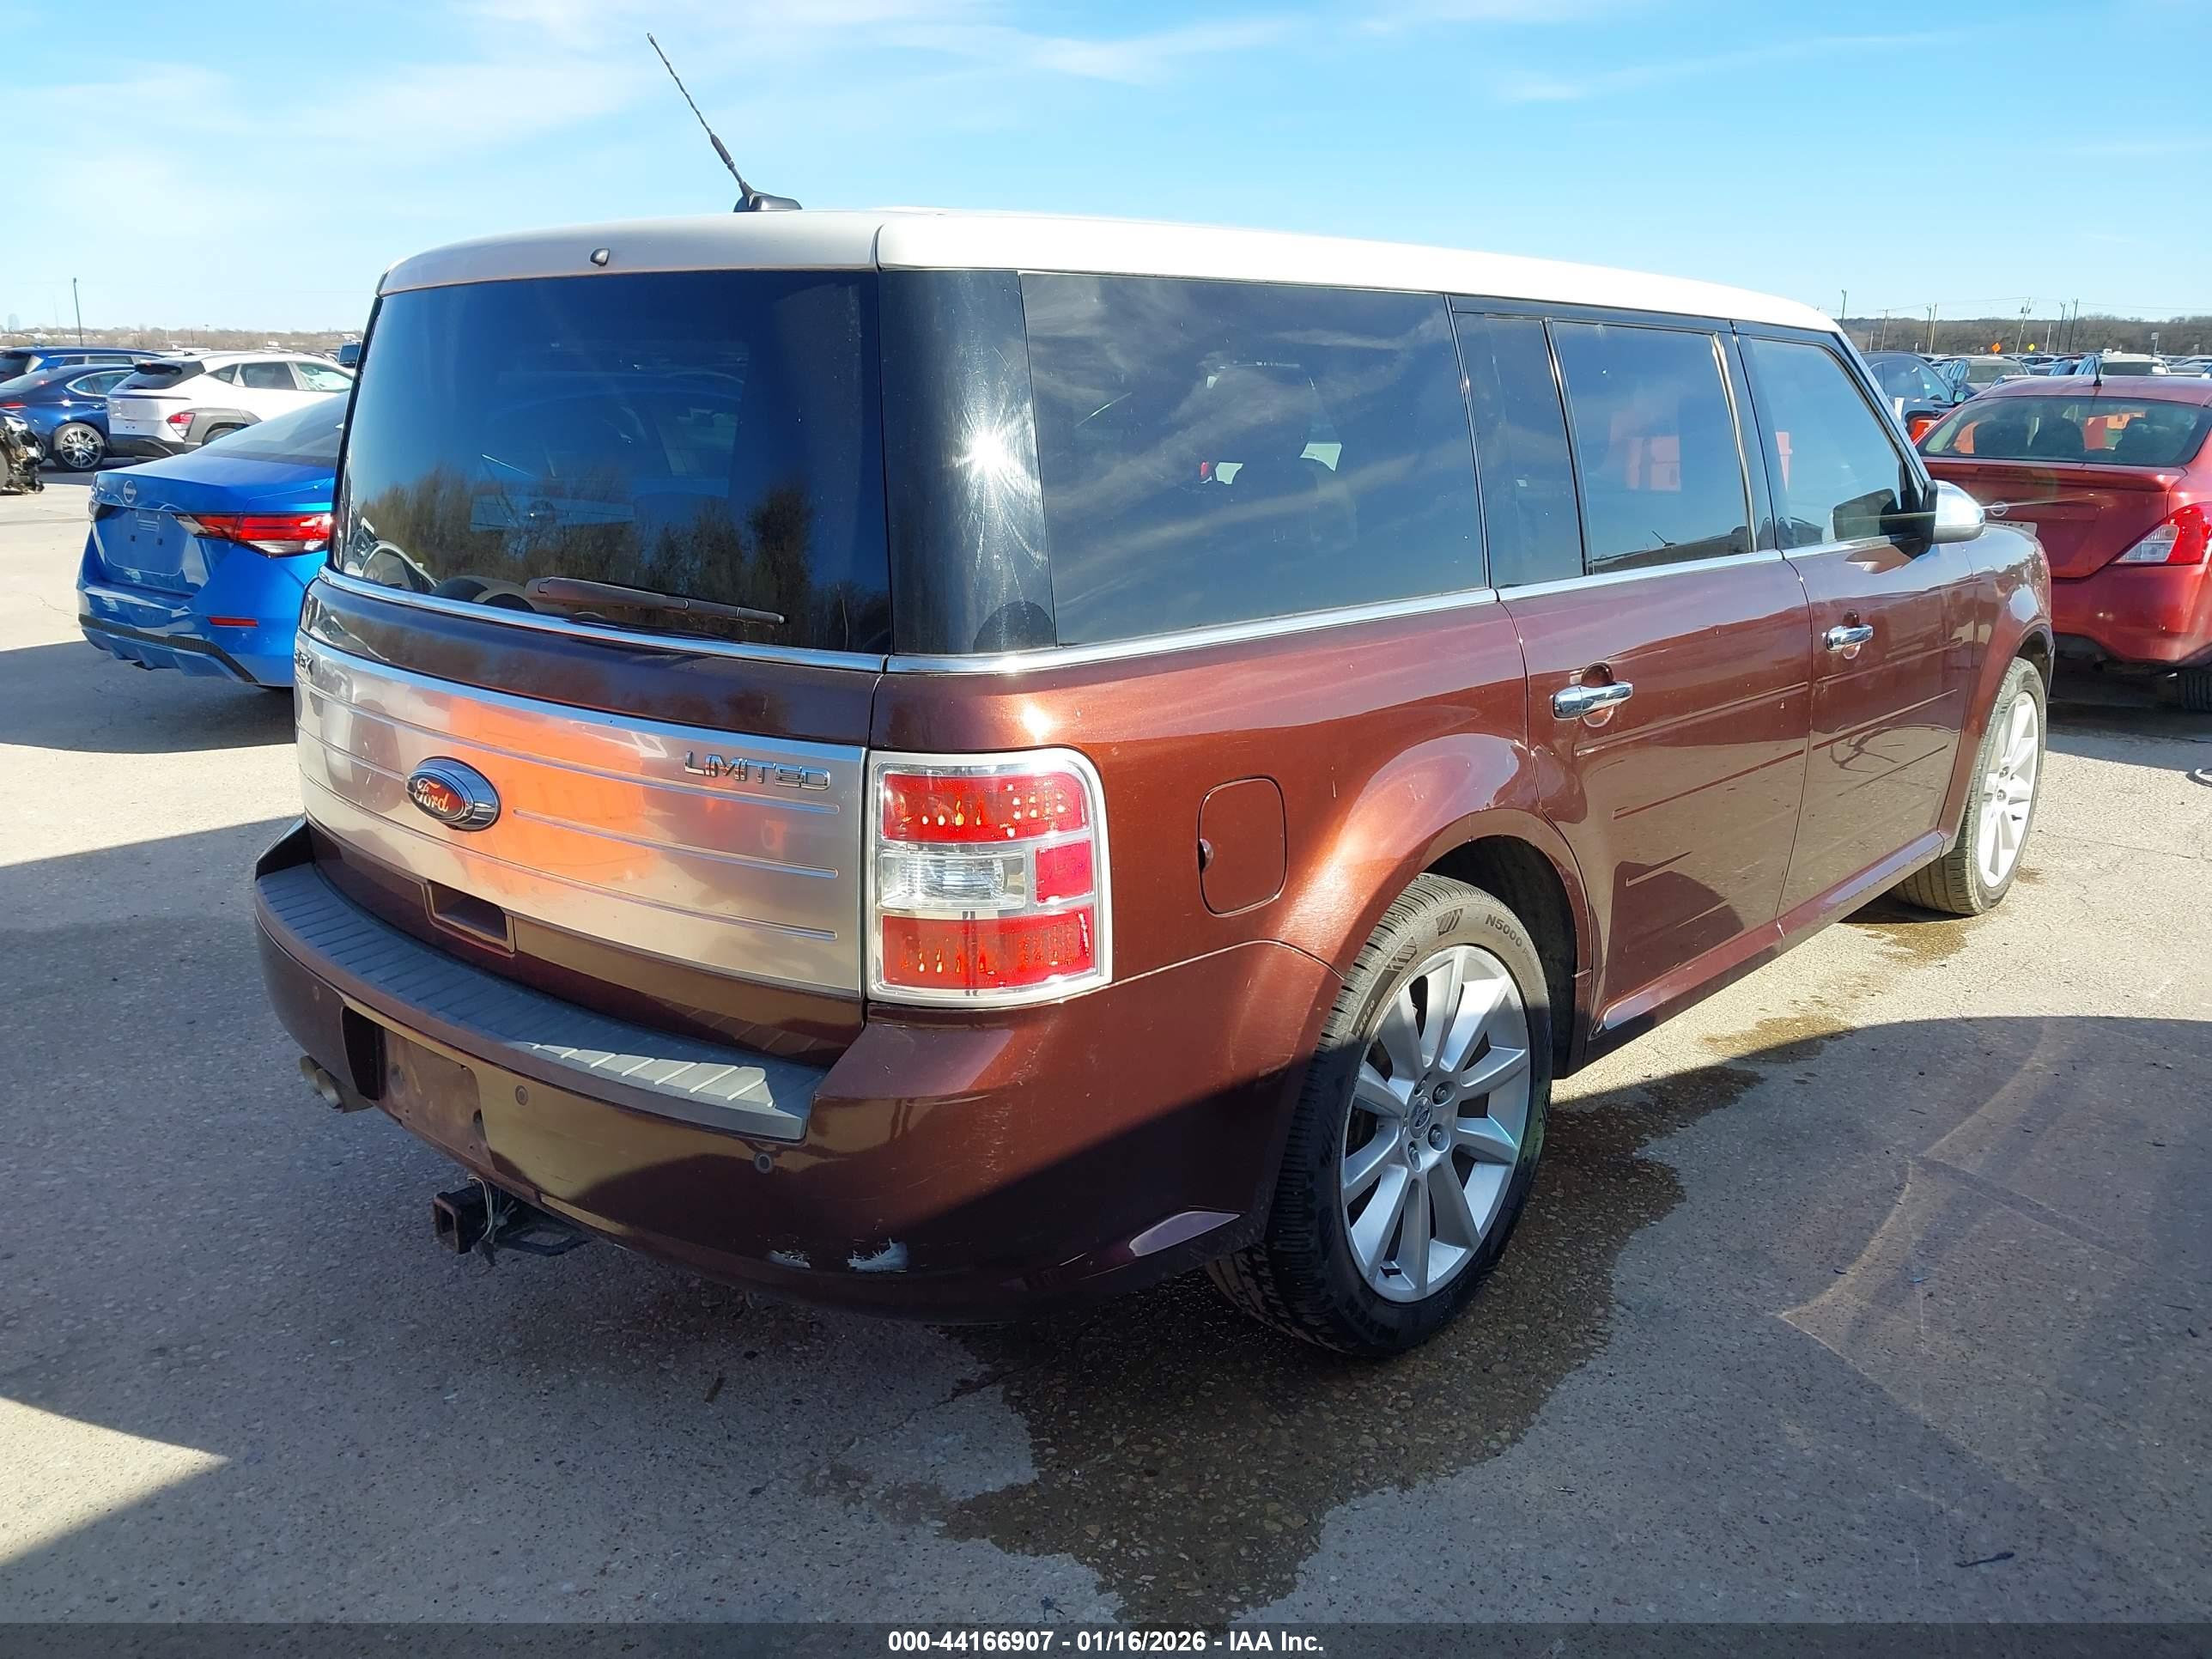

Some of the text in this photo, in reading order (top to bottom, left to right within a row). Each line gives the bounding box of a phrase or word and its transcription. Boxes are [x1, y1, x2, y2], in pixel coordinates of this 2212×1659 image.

[684, 750, 832, 792] LIMITED
[414, 778, 449, 813] Ford
[1485, 913, 1523, 947] N5000
